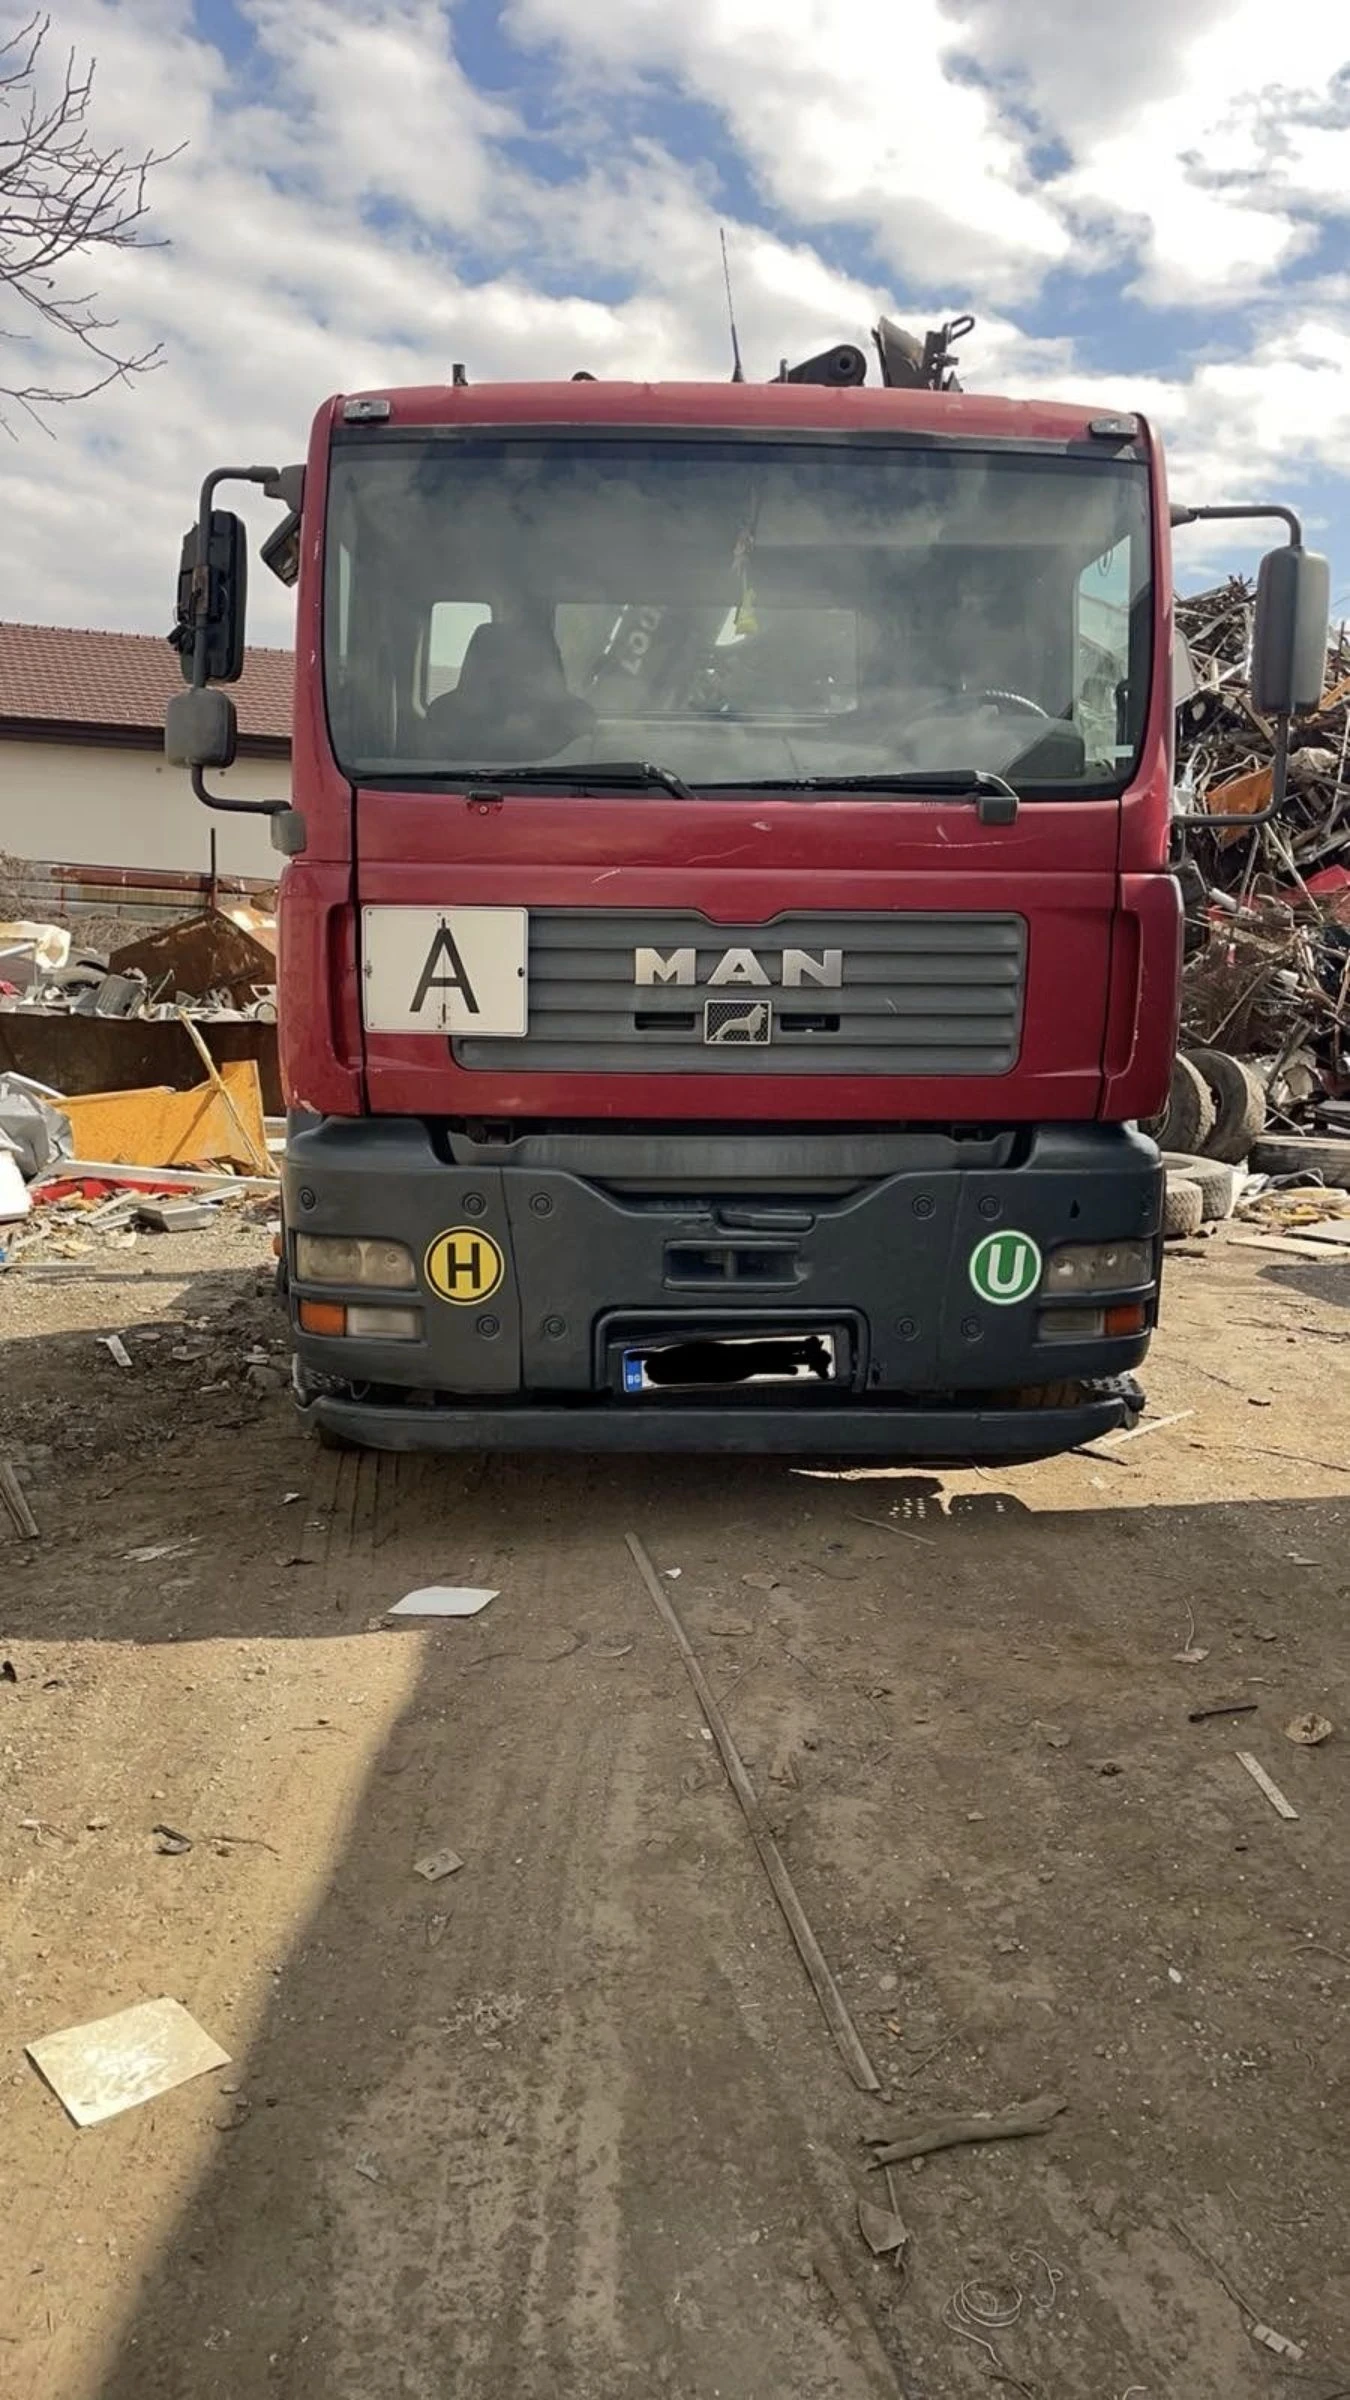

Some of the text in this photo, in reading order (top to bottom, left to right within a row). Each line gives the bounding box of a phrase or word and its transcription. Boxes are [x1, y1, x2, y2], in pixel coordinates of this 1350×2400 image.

[409, 928, 480, 1014] A
[635, 948, 842, 987] MAN
[447, 1242, 481, 1289] H
[988, 1244, 1026, 1294] U
